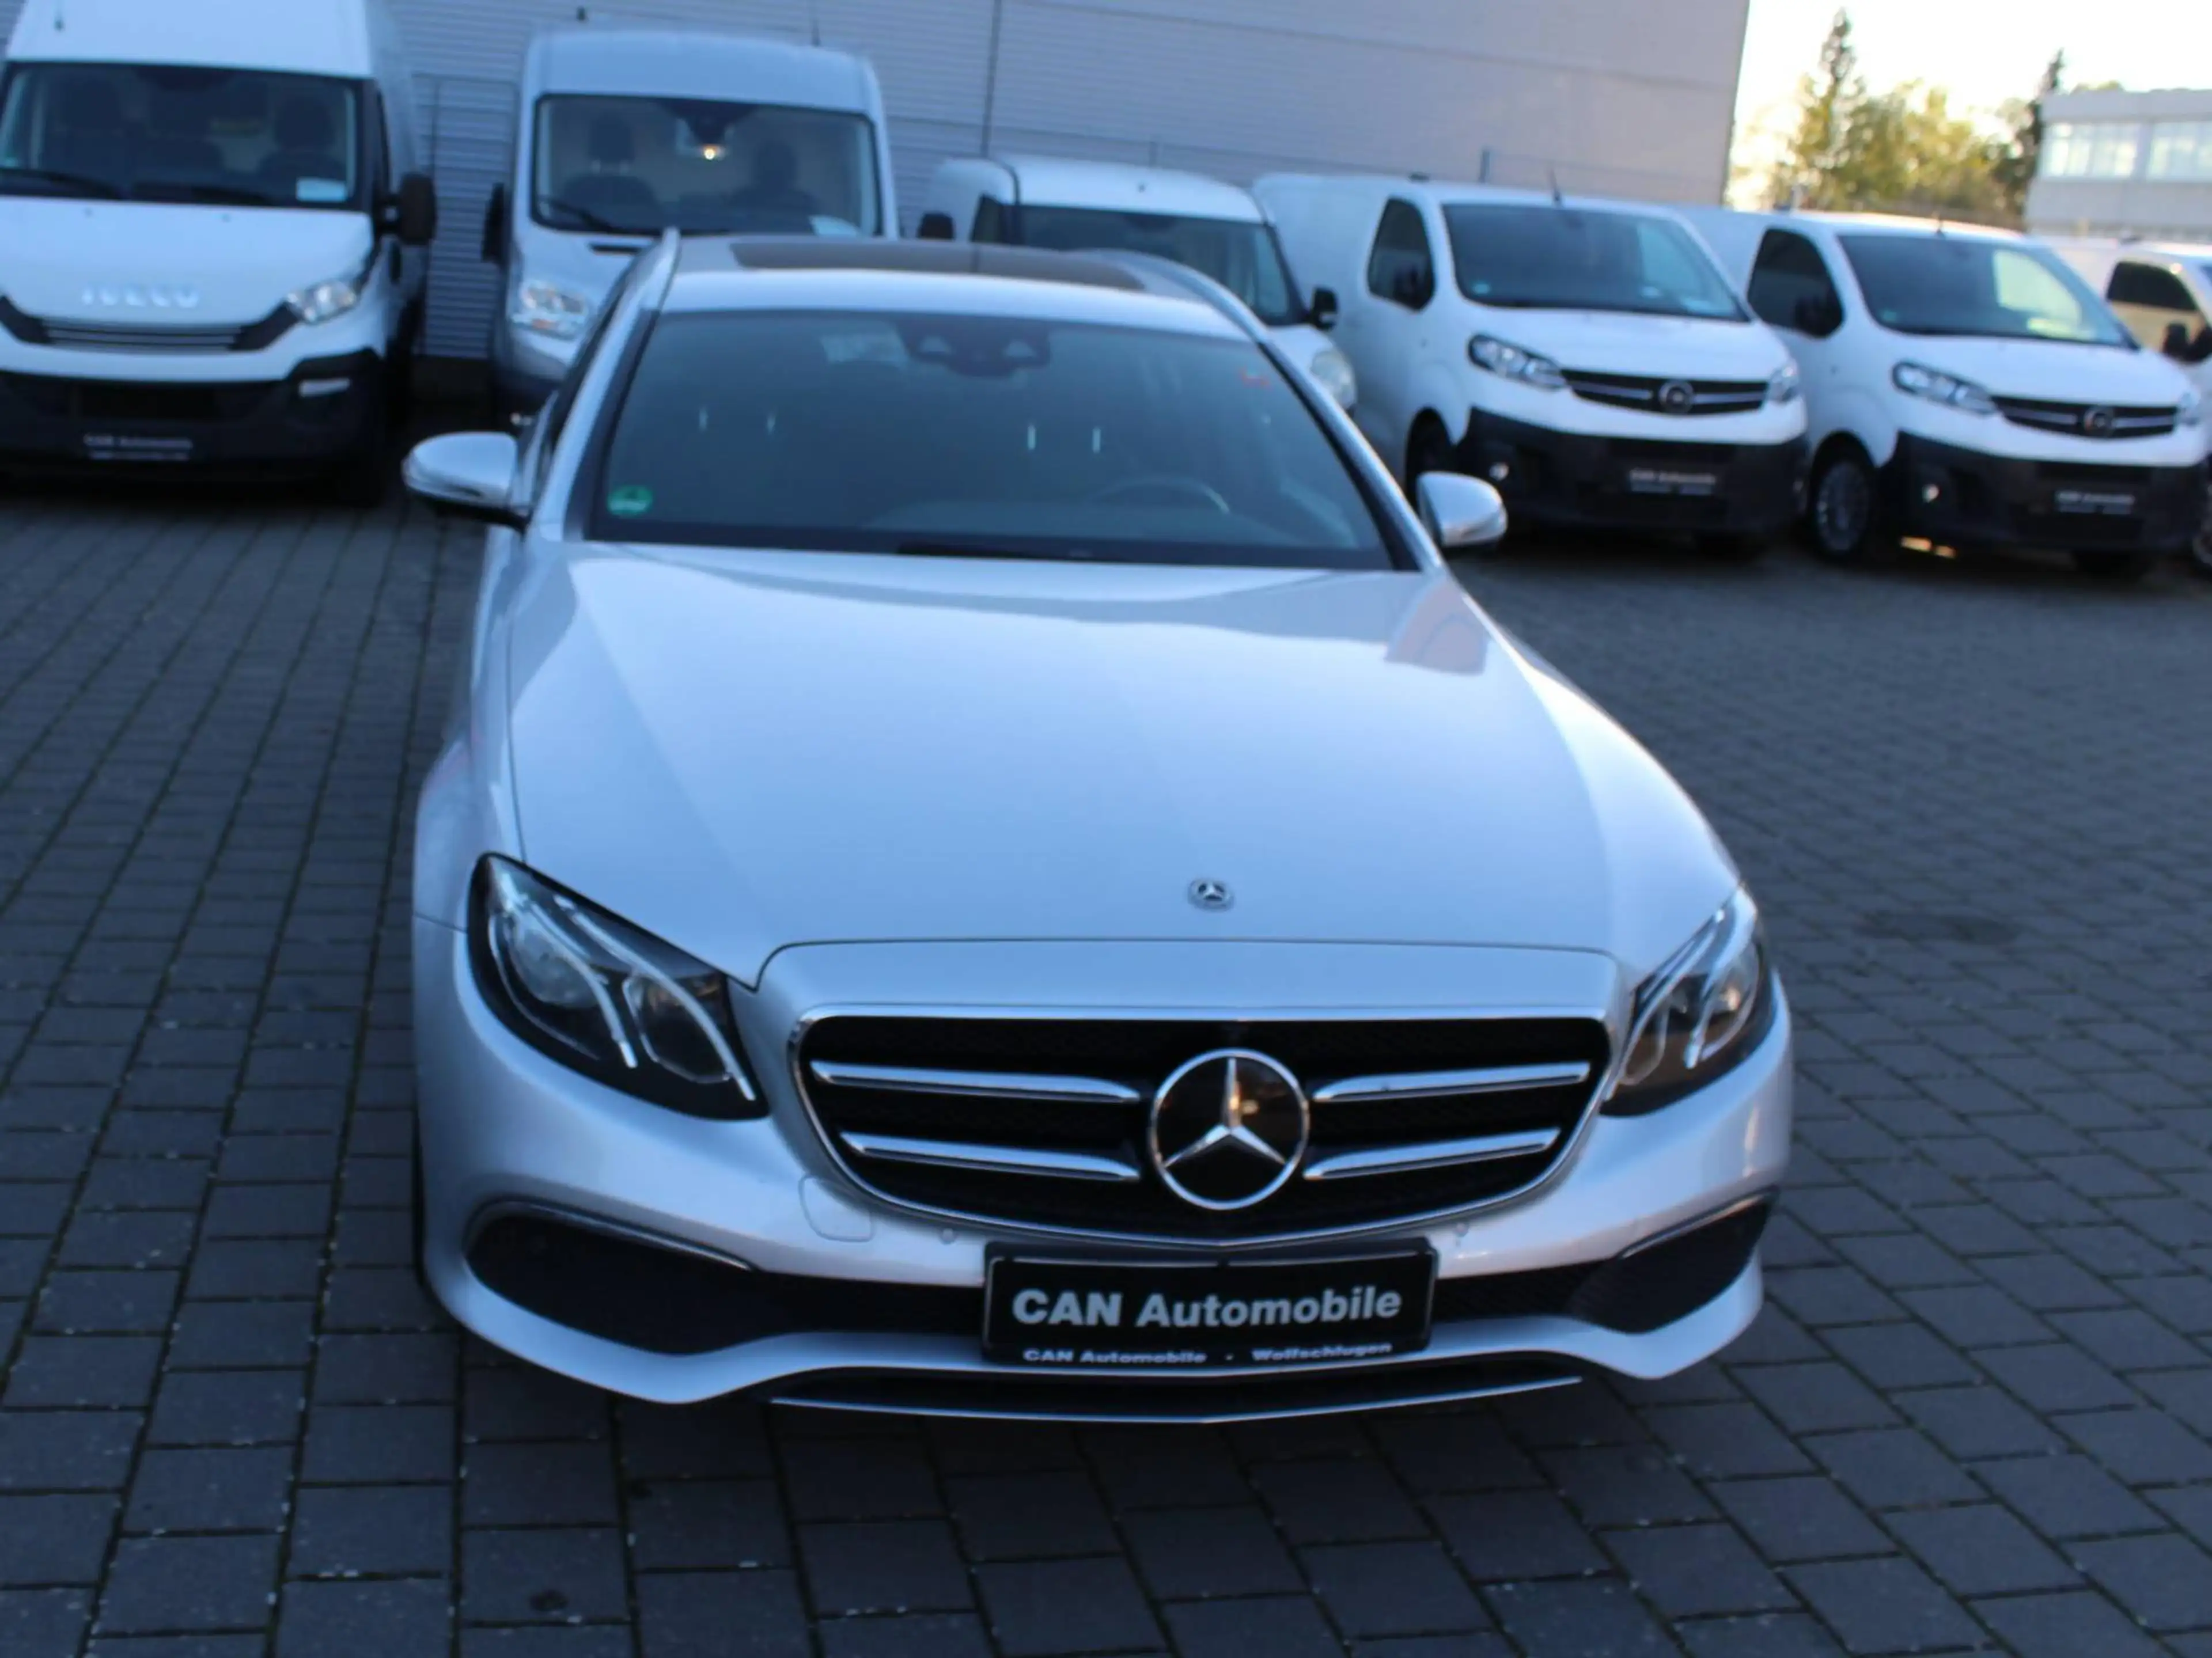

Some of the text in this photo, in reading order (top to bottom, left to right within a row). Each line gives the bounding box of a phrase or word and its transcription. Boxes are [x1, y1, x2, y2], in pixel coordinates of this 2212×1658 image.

[1012, 1285, 1402, 1327] CAN Automobile
[1022, 1348, 1074, 1362] CAN
[1080, 1349, 1208, 1364] Automobile
